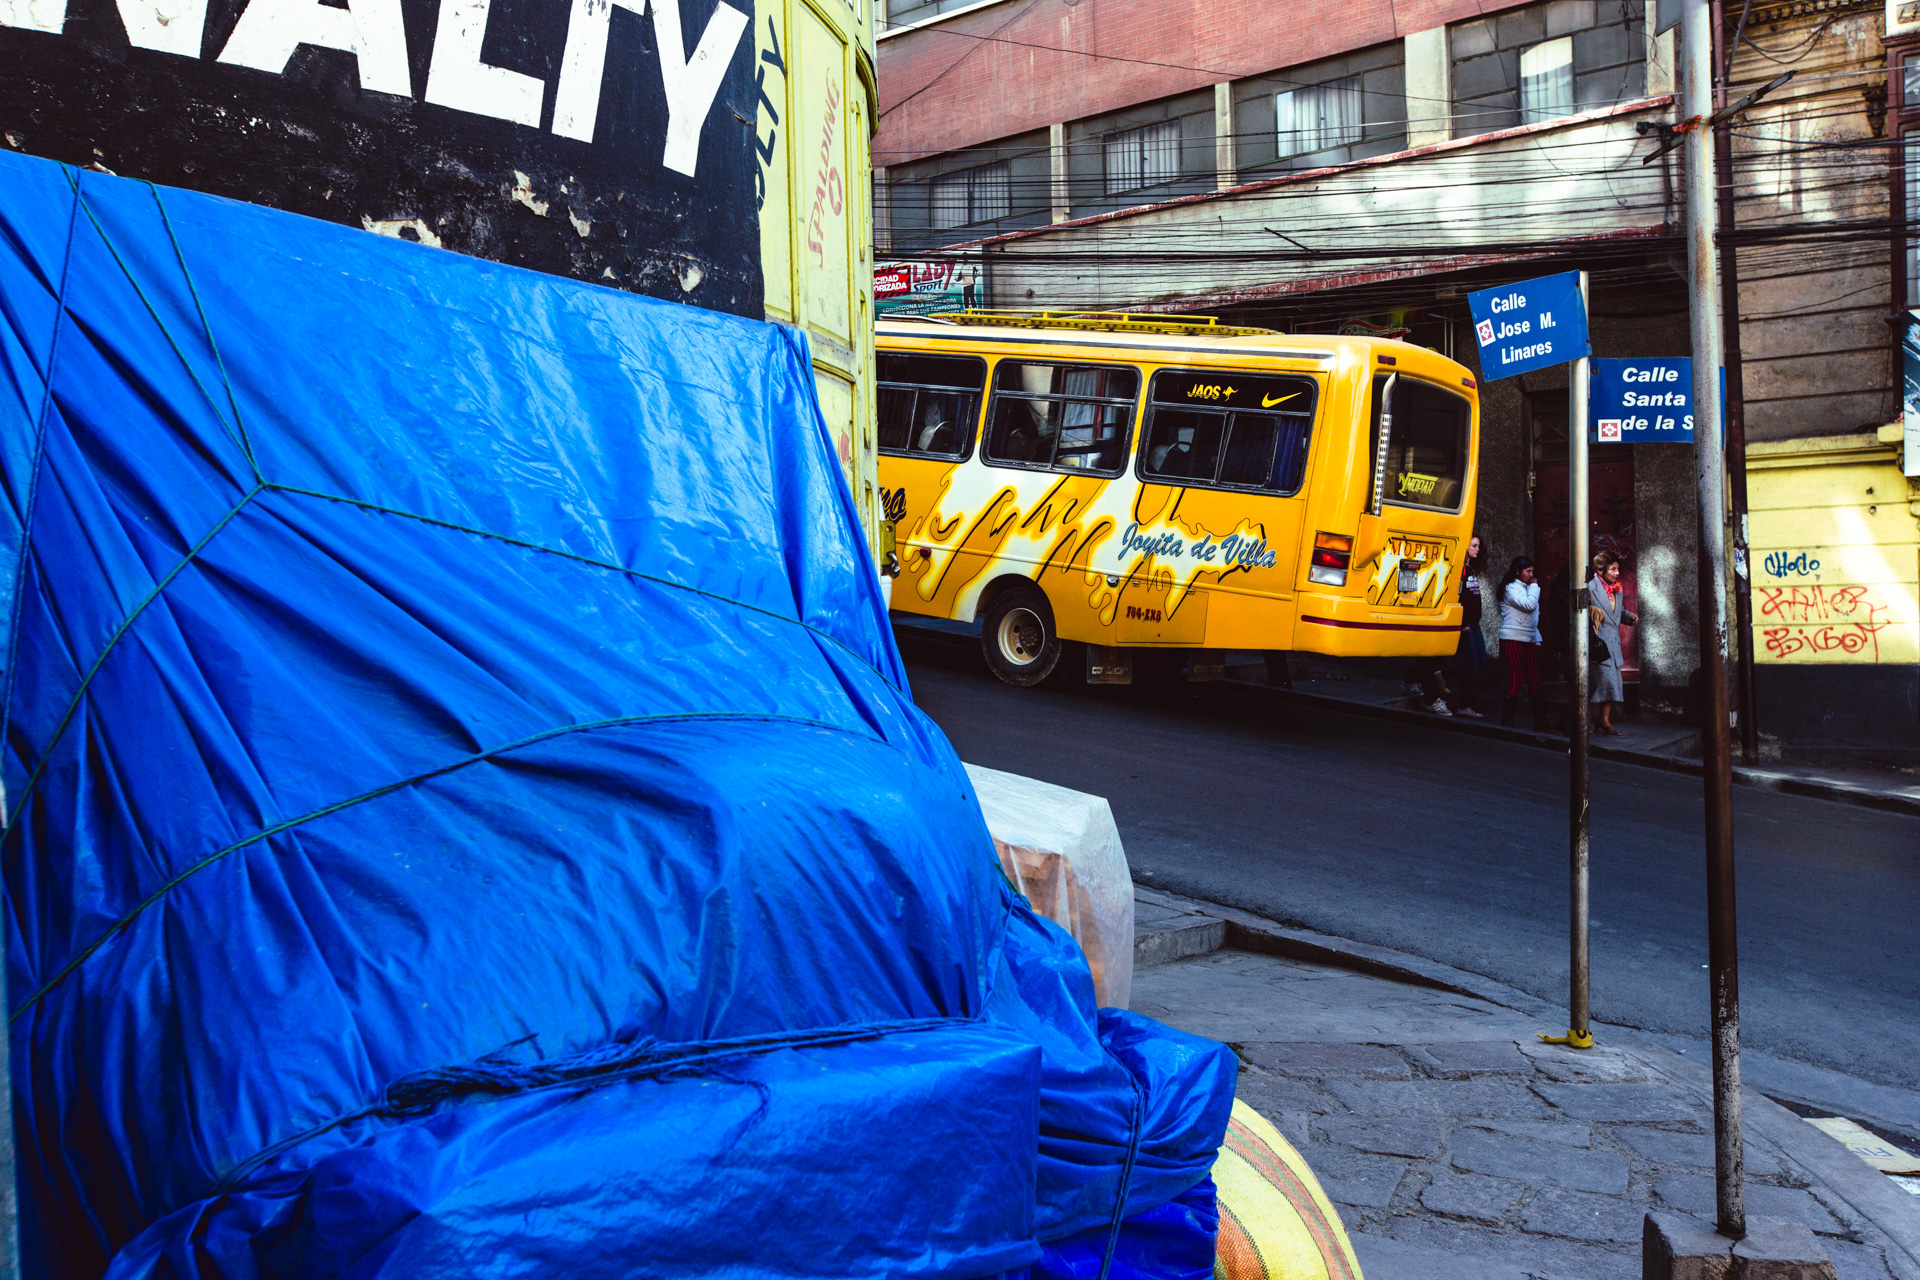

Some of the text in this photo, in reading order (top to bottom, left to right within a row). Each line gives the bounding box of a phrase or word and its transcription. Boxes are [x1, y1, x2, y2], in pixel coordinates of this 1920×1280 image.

[0, 0, 749, 178] ALTY
[807, 66, 841, 271] SPALDING
[912, 260, 956, 291] LADY
[913, 279, 944, 293] Sport
[1491, 292, 1527, 314] Calle
[1497, 311, 1557, 339] Jose M.
[1501, 340, 1553, 365] Linares
[1622, 366, 1679, 383] Calle
[1186, 383, 1222, 400] JAOS
[1621, 390, 1686, 407] Santa
[1621, 415, 1649, 431] de
[1654, 415, 1675, 431] la
[1406, 477, 1436, 496] MOPAR
[1117, 521, 1278, 569] Joyita de Villa
[1389, 540, 1440, 560] MOPAR
